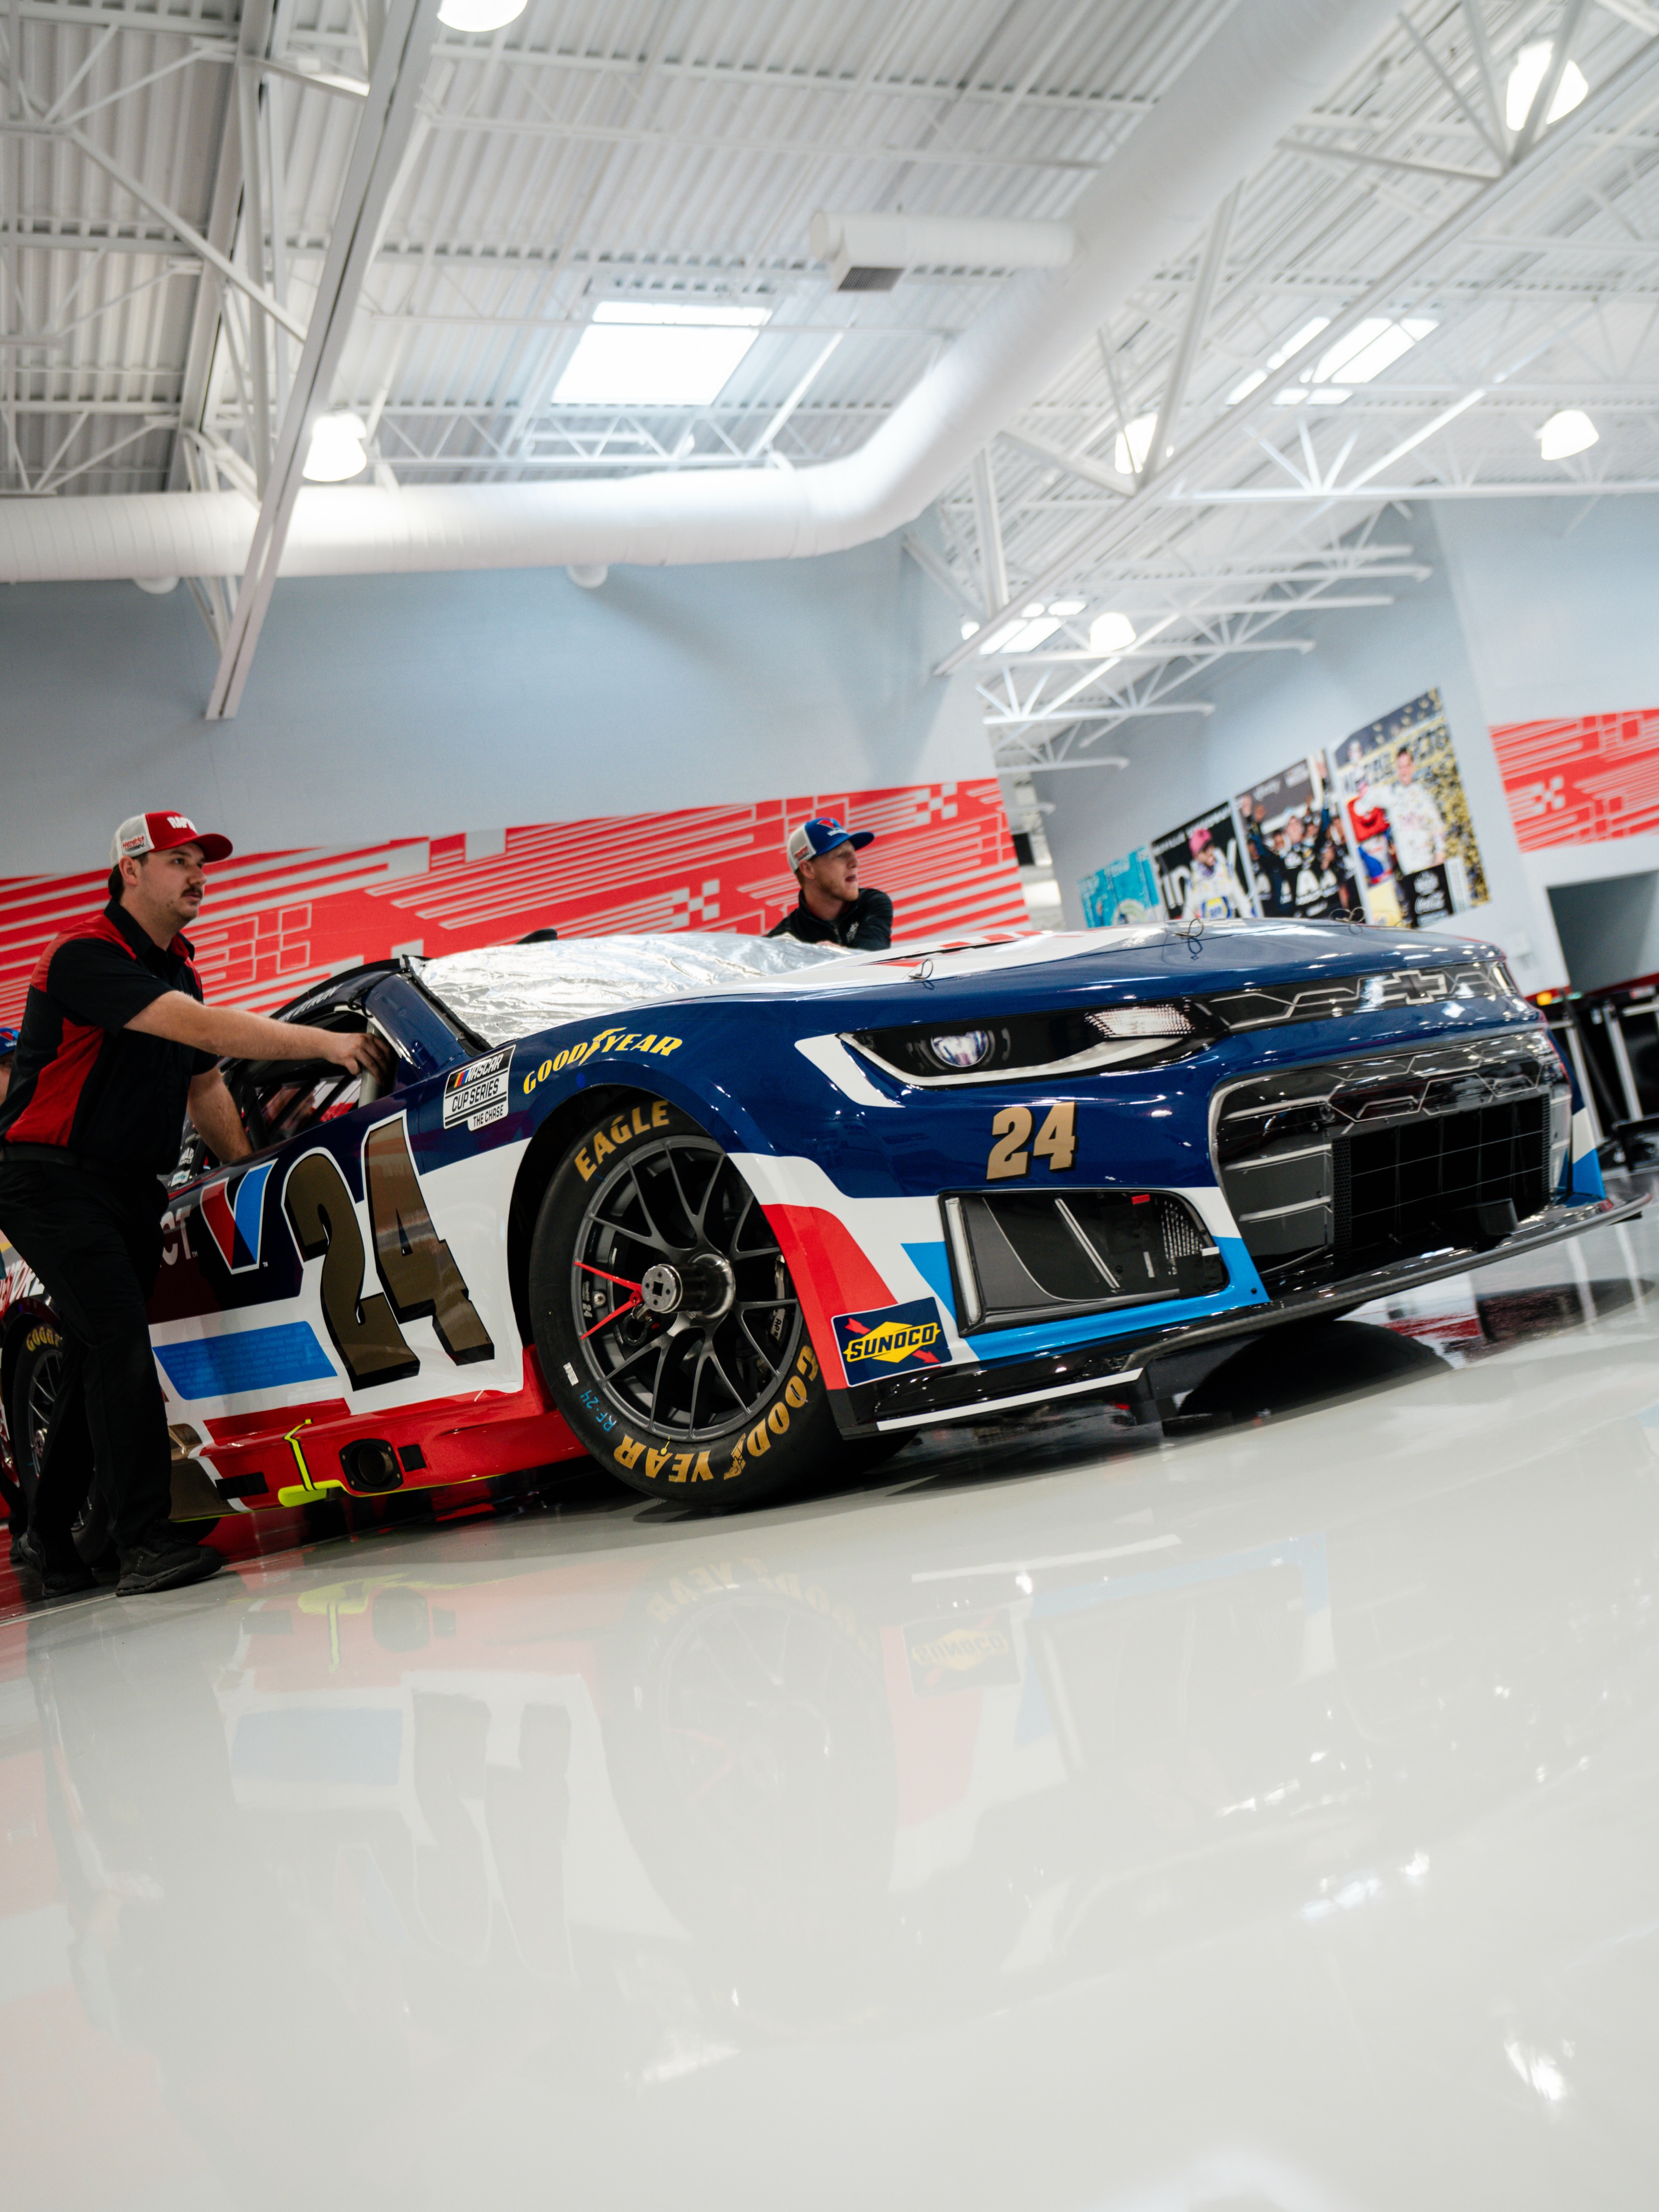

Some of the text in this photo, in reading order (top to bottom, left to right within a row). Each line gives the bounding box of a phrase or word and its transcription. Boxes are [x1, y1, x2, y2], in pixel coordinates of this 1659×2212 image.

[464, 1054, 504, 1083] NASCAR
[523, 1027, 683, 1094] GOODYEAR
[451, 1078, 500, 1112] CUP SERIES
[473, 1104, 503, 1128] THE CHASE
[574, 1100, 670, 1182] EAGLE
[986, 1101, 1078, 1182] 24
[282, 1112, 495, 1391] 24
[849, 1325, 934, 1359] SUNOCO
[613, 1345, 818, 1482] GOODYEAR
